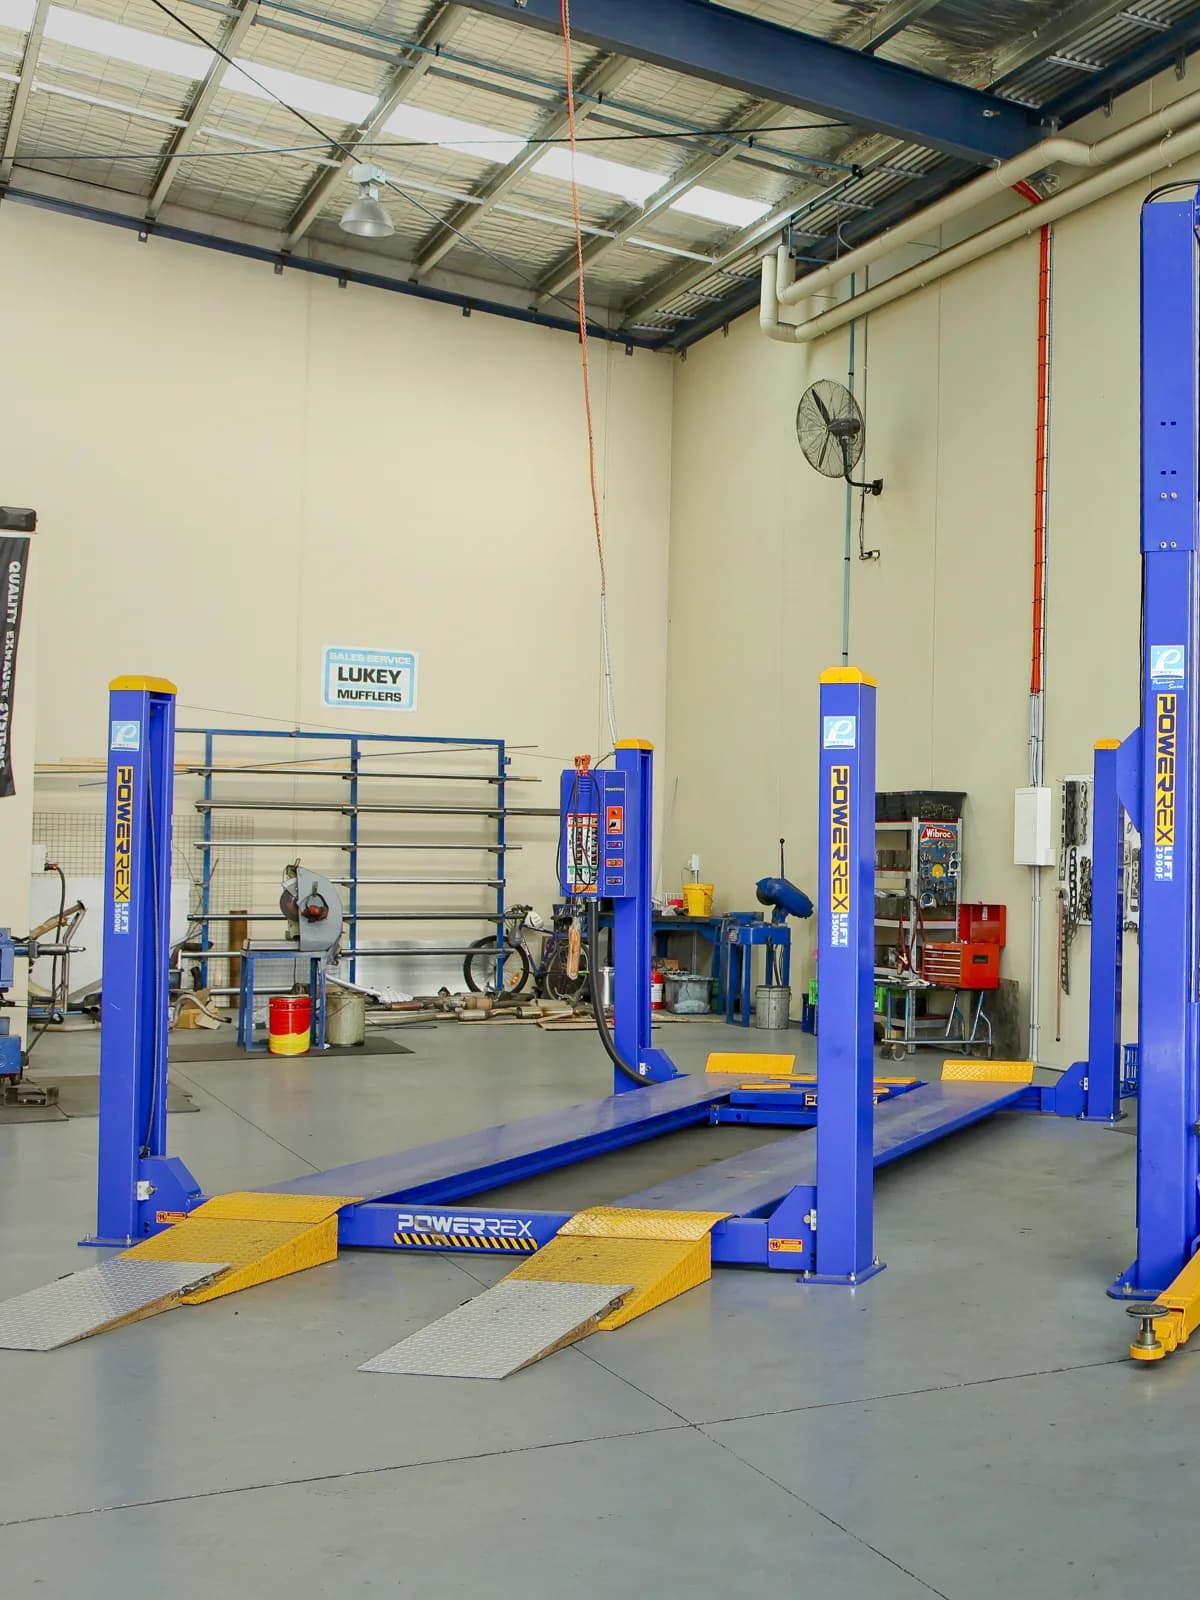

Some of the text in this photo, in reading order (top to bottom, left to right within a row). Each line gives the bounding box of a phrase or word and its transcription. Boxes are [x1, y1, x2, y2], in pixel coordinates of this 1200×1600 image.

[6, 560, 21, 625] QUALITY
[1, 630, 15, 698] EXHAUST
[338, 666, 402, 685] LUKEY
[367, 654, 411, 665] SERVICE
[337, 689, 402, 702] MUFFLERS
[1156, 696, 1175, 843] POWERREX
[116, 768, 132, 900] POWERREX
[832, 768, 848, 911] POWERREX
[1155, 846, 1163, 880] 2900F
[1164, 846, 1173, 881] LIFT
[121, 903, 129, 933] LIFT
[831, 913, 839, 945] 3500W
[839, 913, 848, 946] LIFT
[398, 1214, 532, 1237] POWERREX
